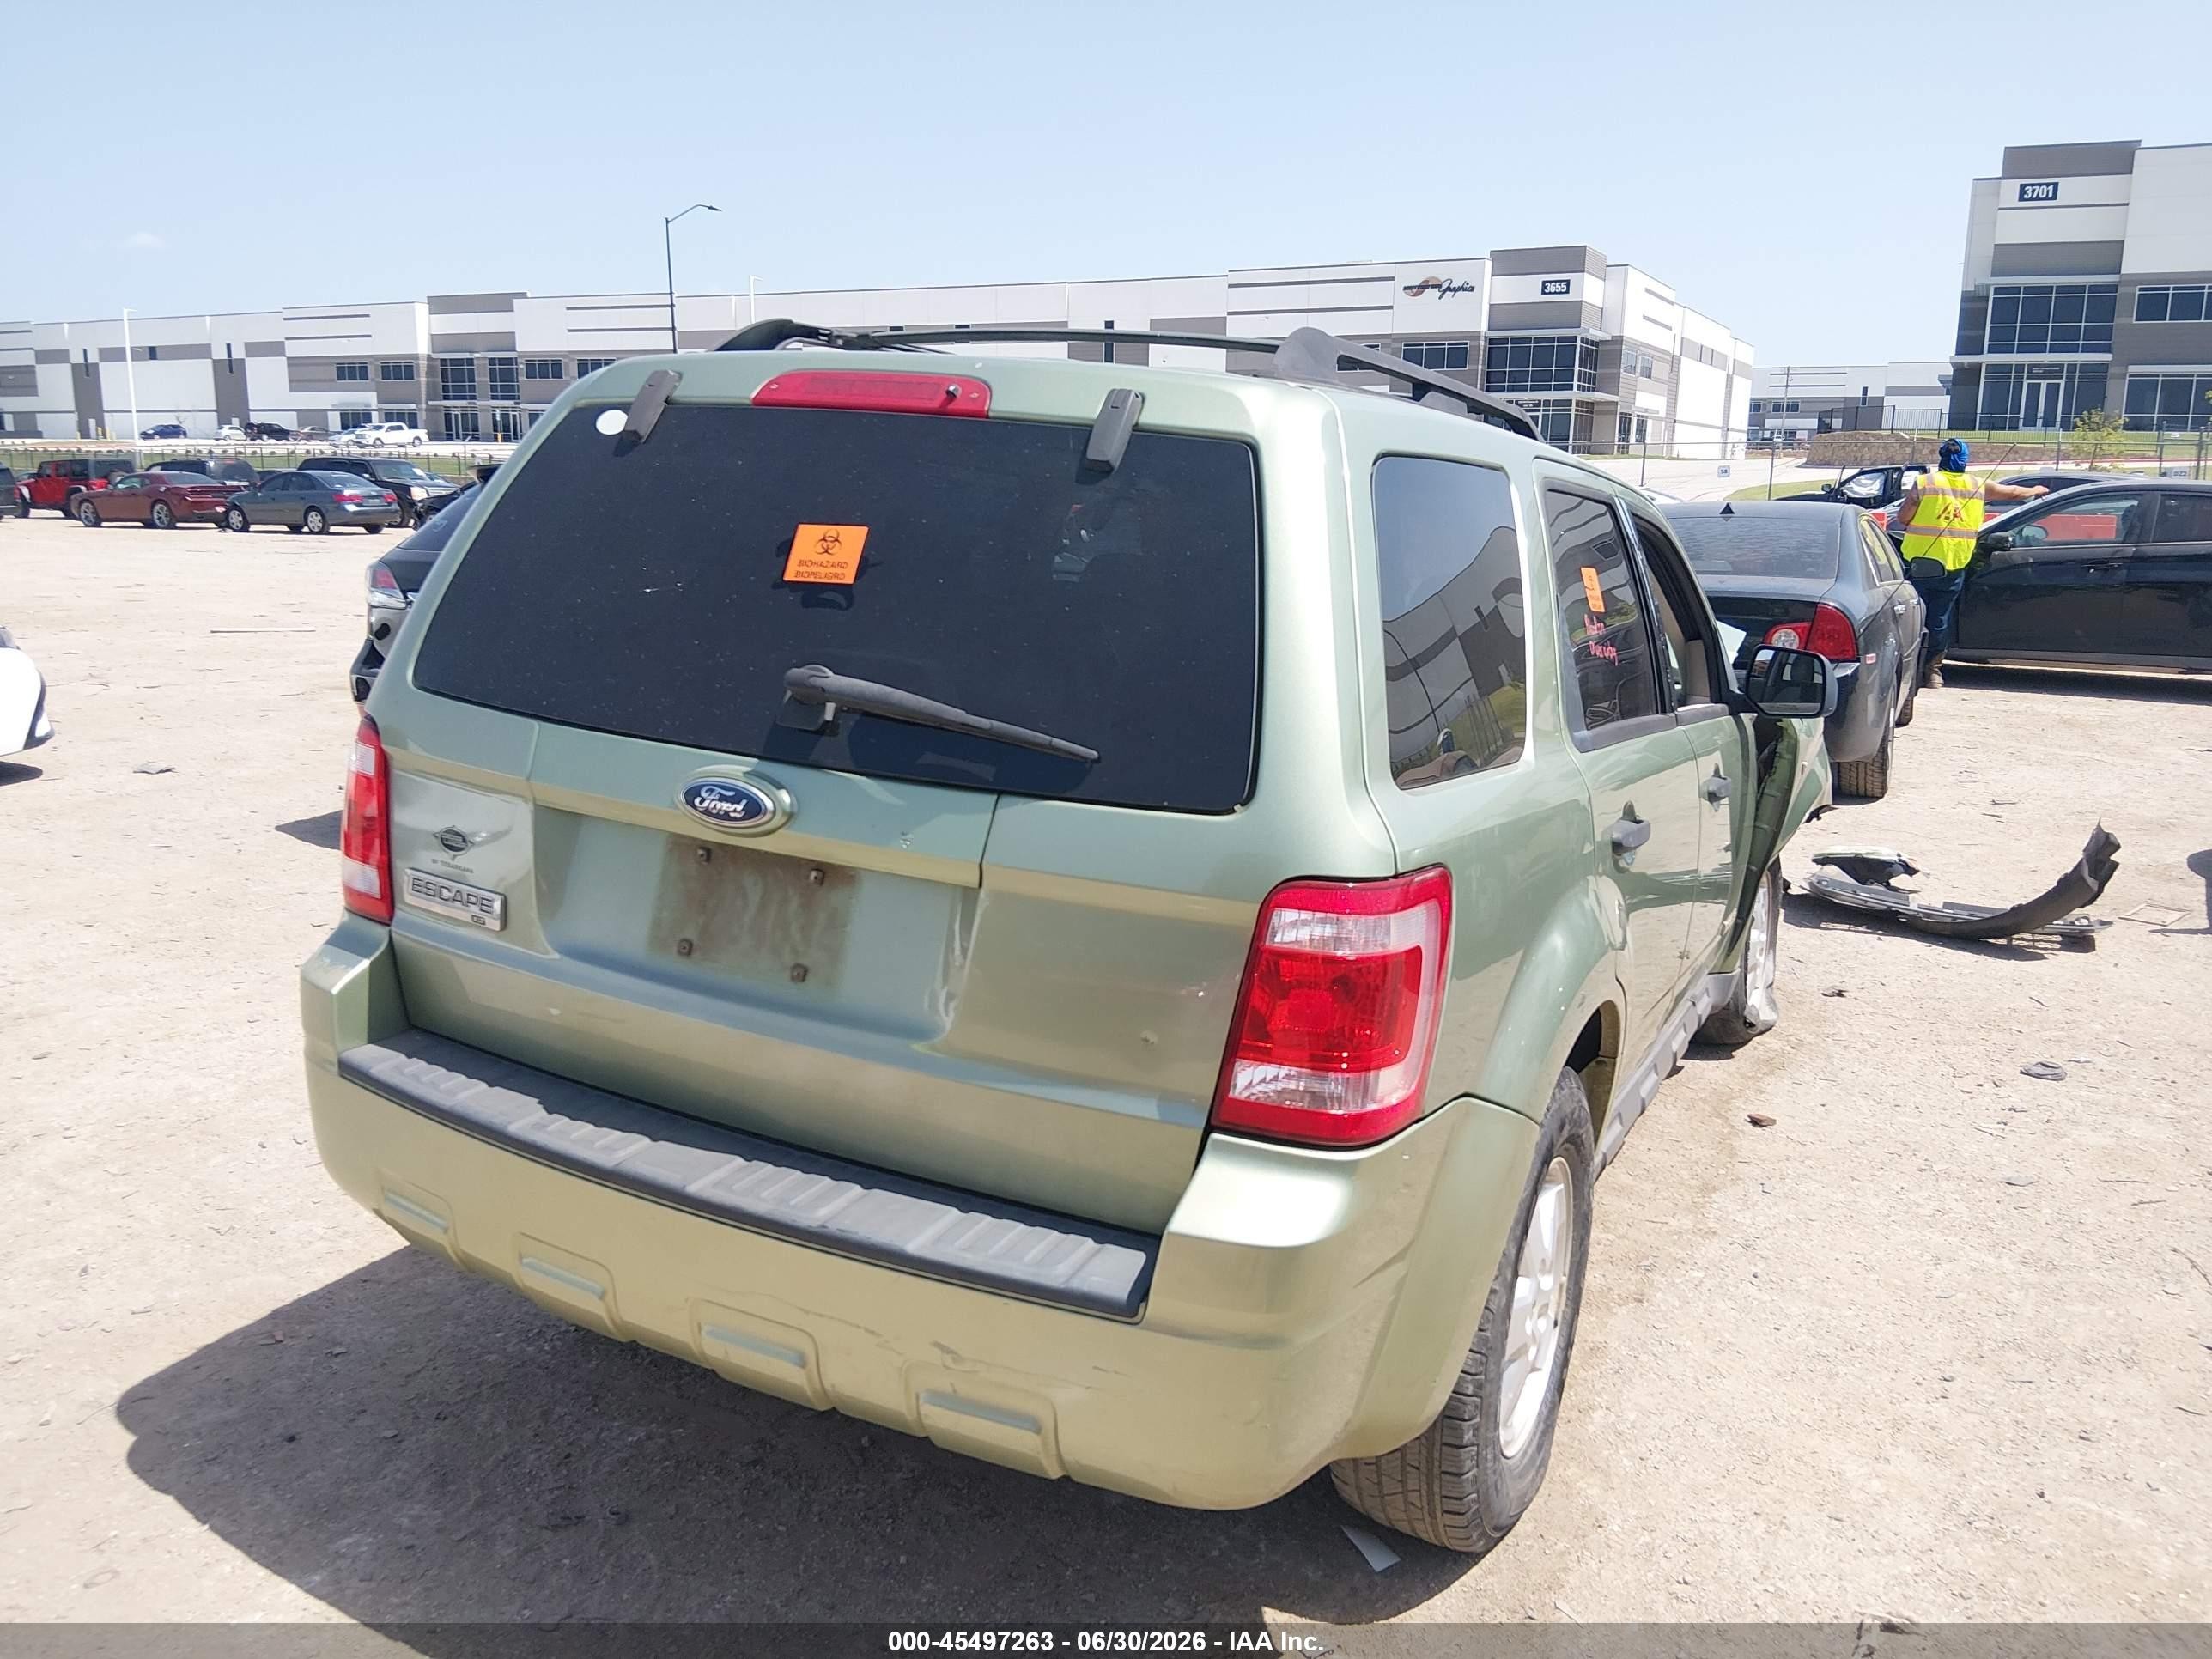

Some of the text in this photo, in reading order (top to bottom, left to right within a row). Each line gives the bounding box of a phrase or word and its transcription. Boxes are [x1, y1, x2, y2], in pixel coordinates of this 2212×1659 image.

[2023, 185, 2054, 198] 3701
[1544, 282, 1567, 293] 3655
[797, 559, 849, 569] BIOHAZARD
[793, 570, 846, 580] BIOPELIGRO
[694, 785, 749, 818] Ford
[411, 877, 495, 915] ESCAPE
